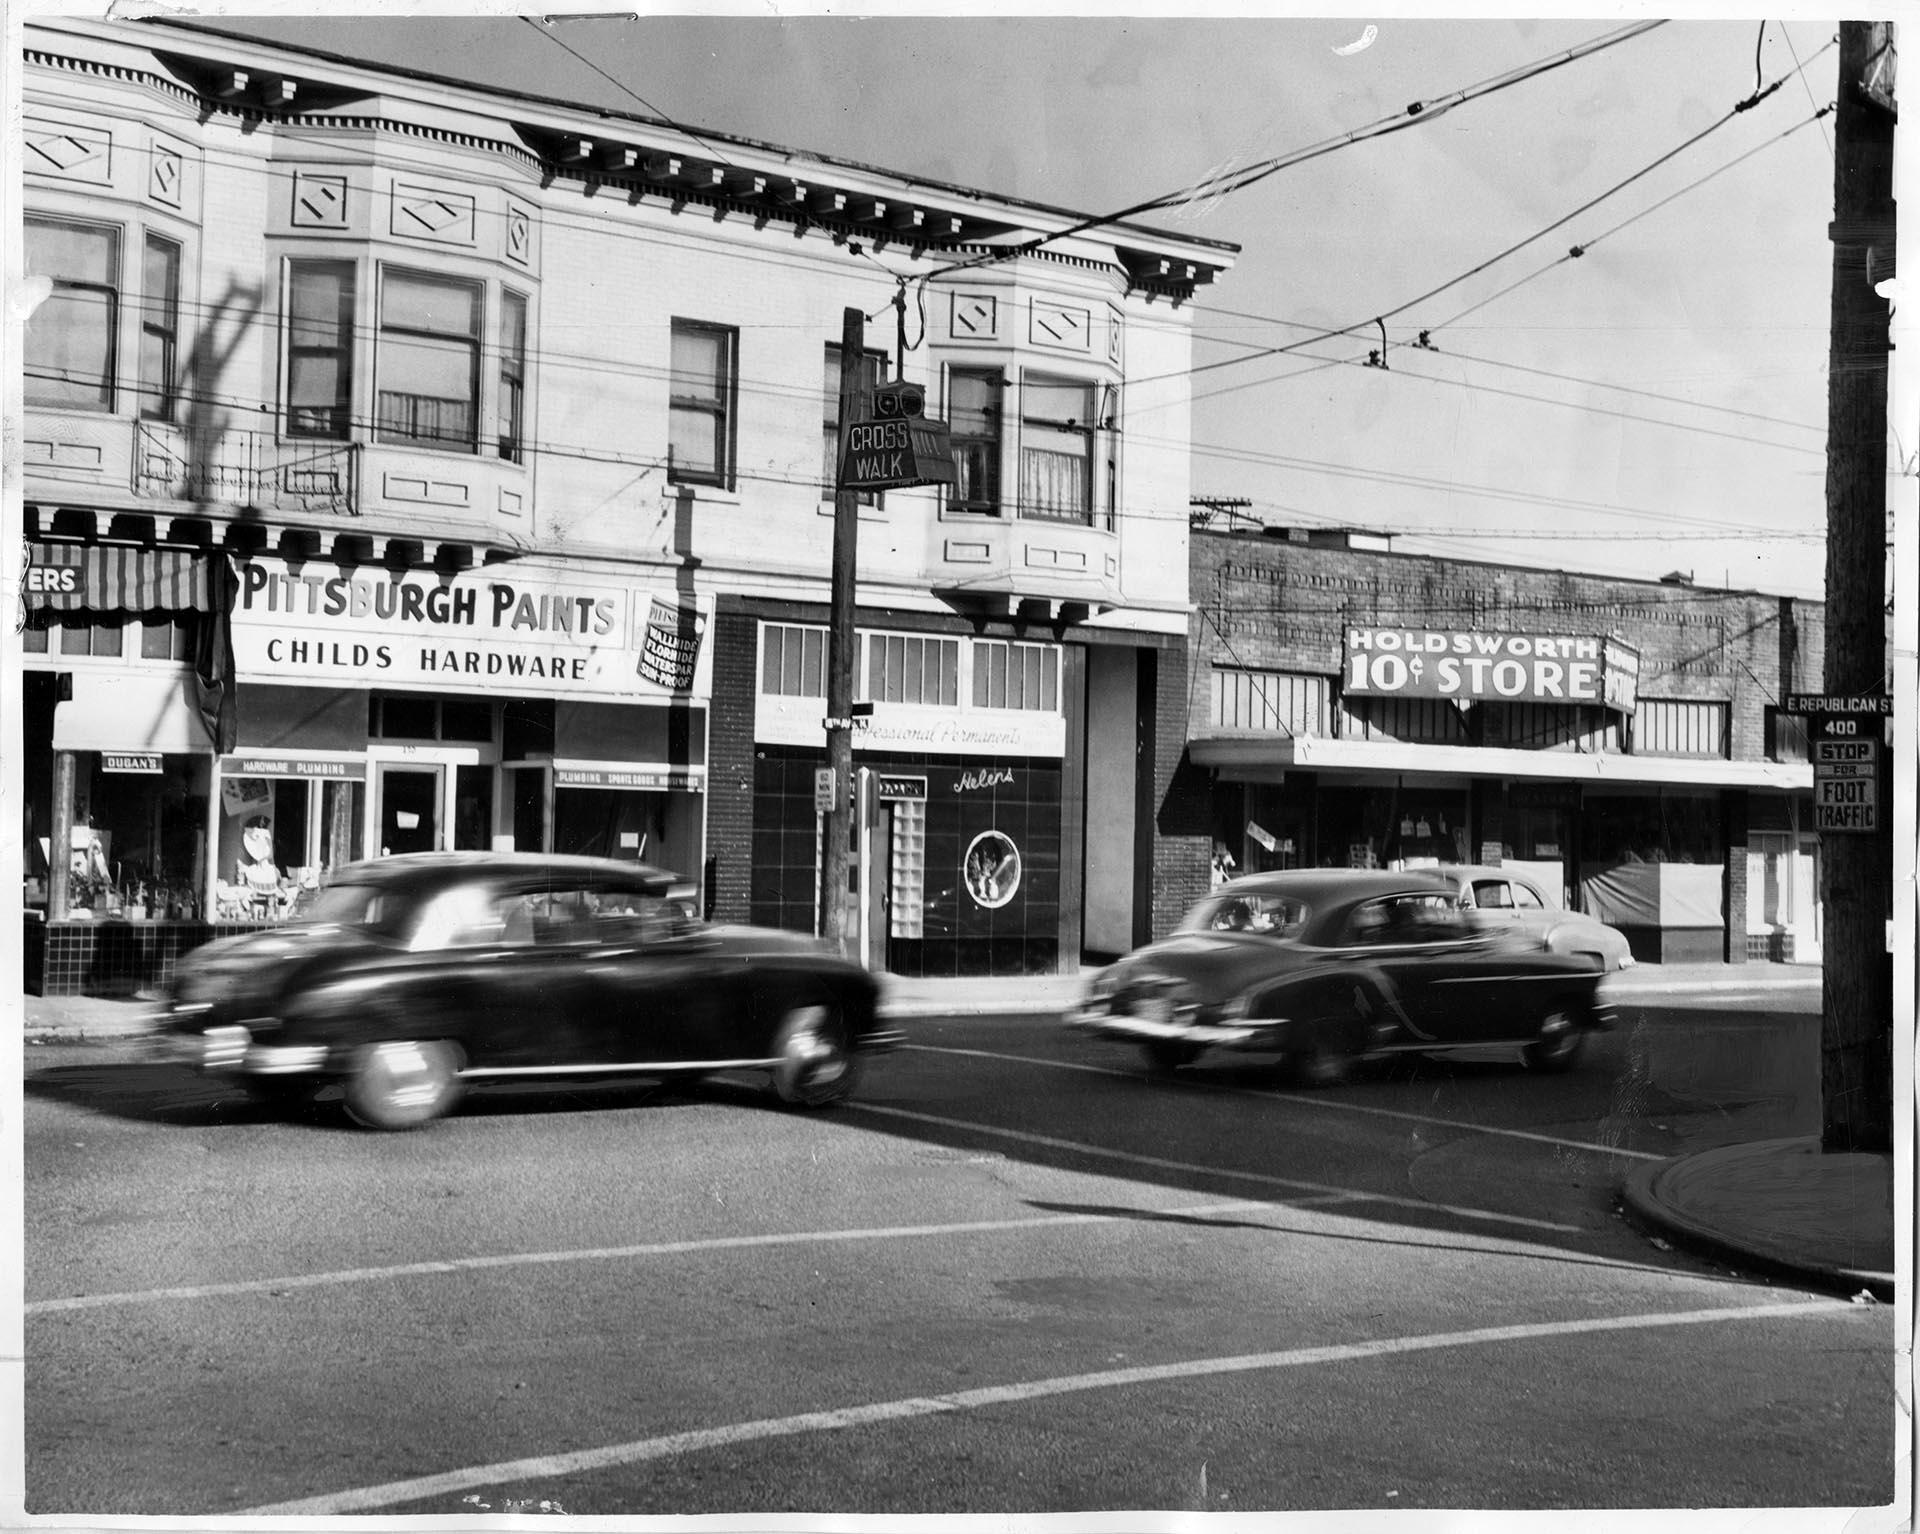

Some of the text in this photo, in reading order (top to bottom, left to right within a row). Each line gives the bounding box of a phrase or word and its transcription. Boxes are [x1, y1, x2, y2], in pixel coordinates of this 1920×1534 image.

[851, 422, 908, 451] CROSS
[856, 452, 903, 480] WALK
[28, 567, 76, 592] ERS
[243, 563, 615, 635] PITTSBURGH PAINTS
[649, 625, 698, 651] WALLHIDE
[1349, 630, 1598, 659] HOLDSWORTH
[267, 638, 586, 681] CHILDS HARDWARE
[1437, 656, 1597, 699] STORE
[1799, 697, 1877, 713] REPUBLICAN
[941, 719, 1021, 746] Permanents
[1825, 720, 1857, 735] 400
[1821, 743, 1870, 760] STOP
[243, 761, 345, 775] HARDWARE PLUMBING
[559, 771, 601, 784] PLUMBING
[1833, 765, 1857, 775] FOR
[1823, 782, 1867, 803] FOOT
[1817, 804, 1873, 827] TRAFFIC
